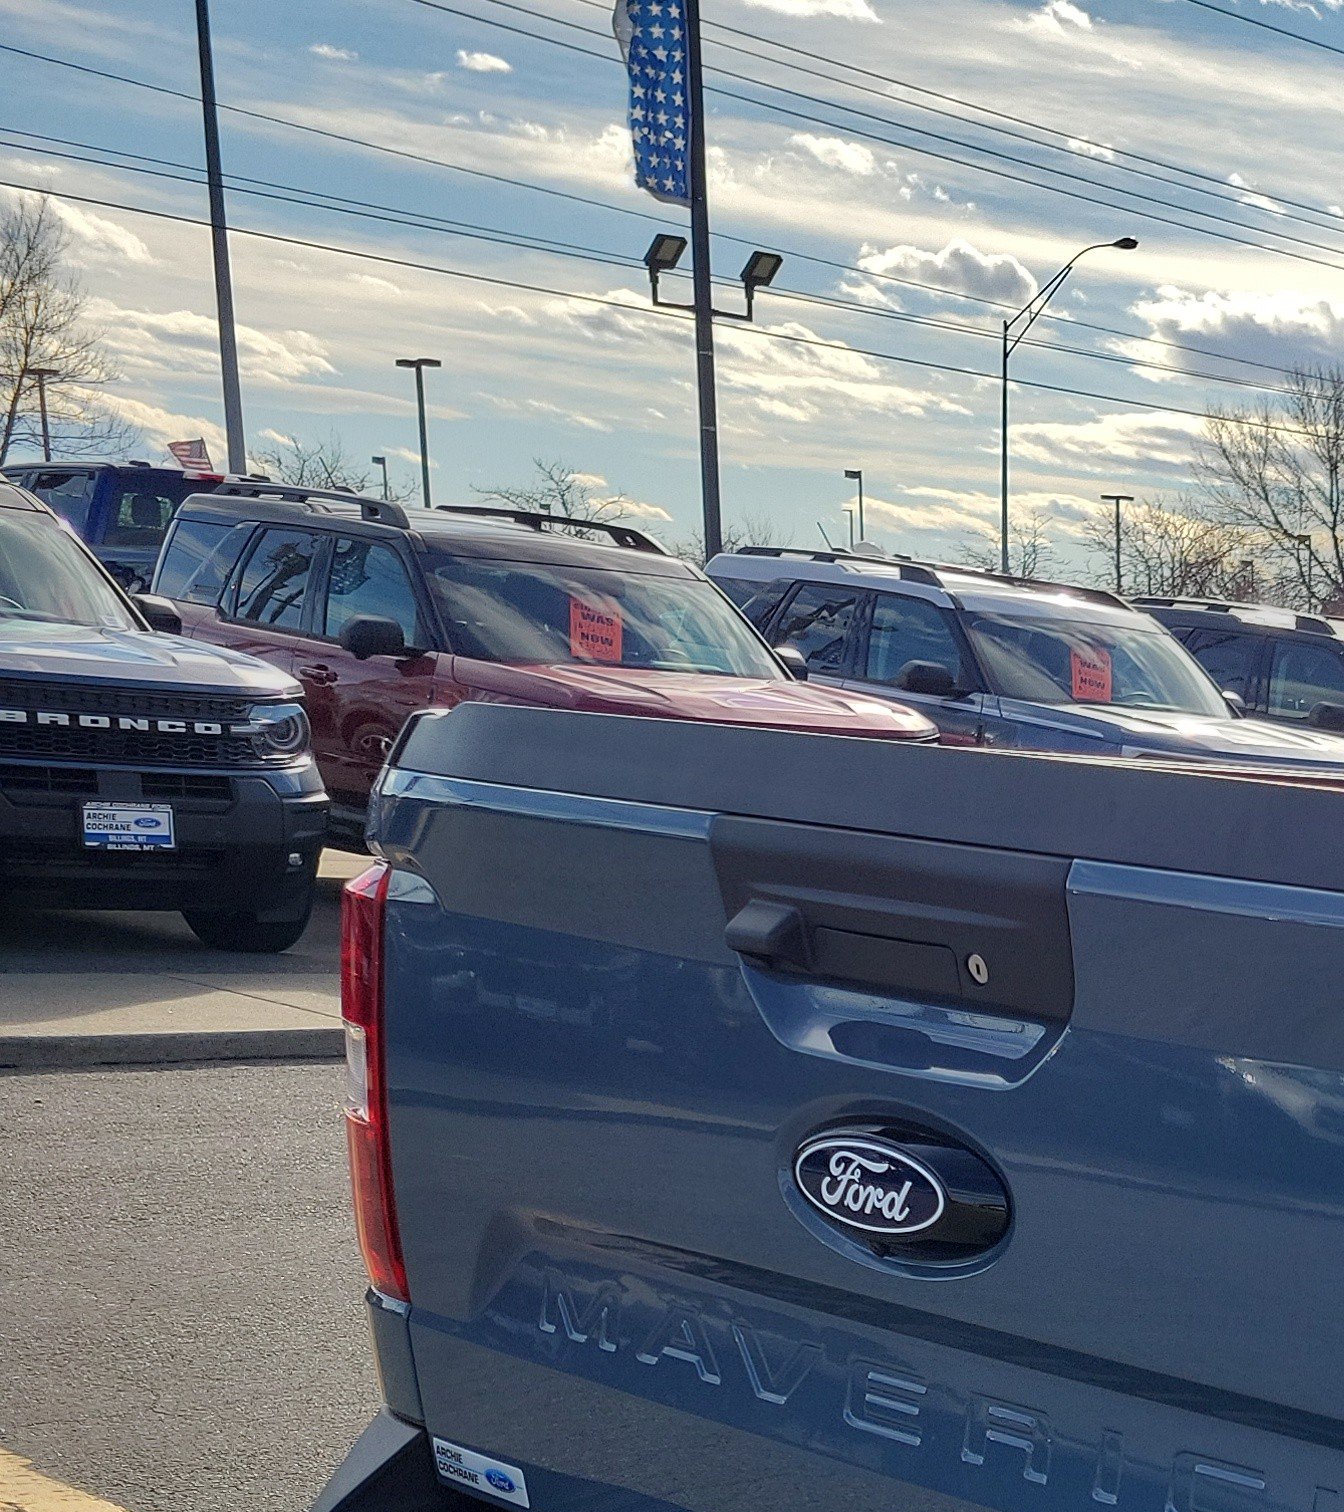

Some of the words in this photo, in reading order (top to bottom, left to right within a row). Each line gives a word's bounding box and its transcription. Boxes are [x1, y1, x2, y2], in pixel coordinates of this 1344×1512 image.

[580, 632, 613, 646] NOW
[0, 708, 222, 735] BRONCO
[86, 812, 117, 820] ARCHIE
[86, 823, 132, 831] COCHRANE
[821, 1151, 913, 1222] Ford
[436, 1445, 463, 1464] ARCHIE
[438, 1461, 480, 1485] COCHRANE
